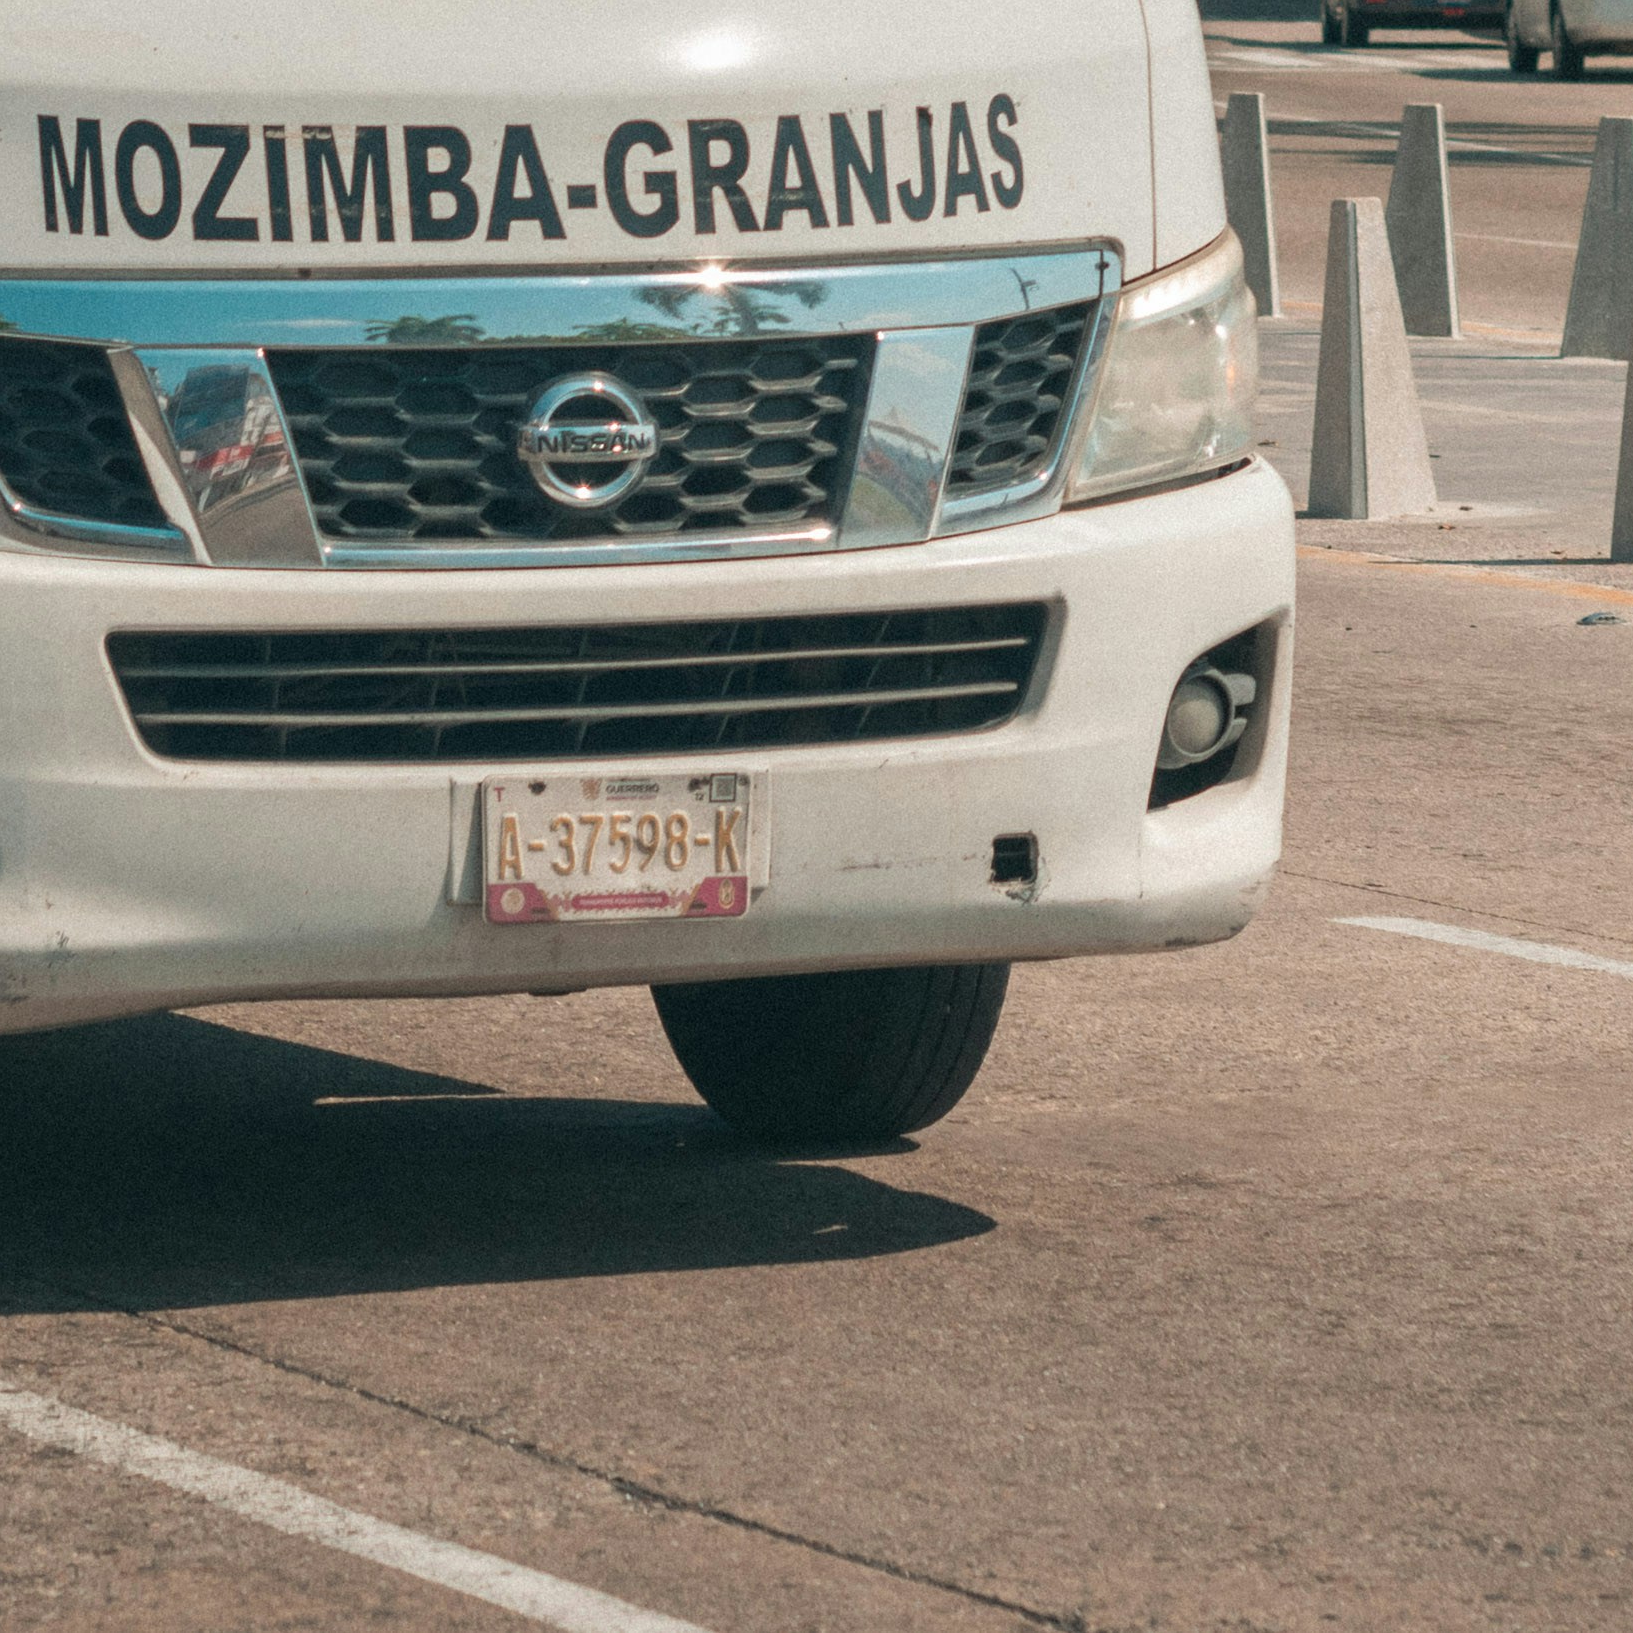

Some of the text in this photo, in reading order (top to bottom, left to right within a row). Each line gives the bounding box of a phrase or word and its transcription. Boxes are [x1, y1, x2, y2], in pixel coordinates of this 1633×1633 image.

[36, 93, 1026, 244] MOZIMBA-GRANJAS
[537, 430, 645, 453] NISSAN
[497, 806, 743, 881] A-37598-K
